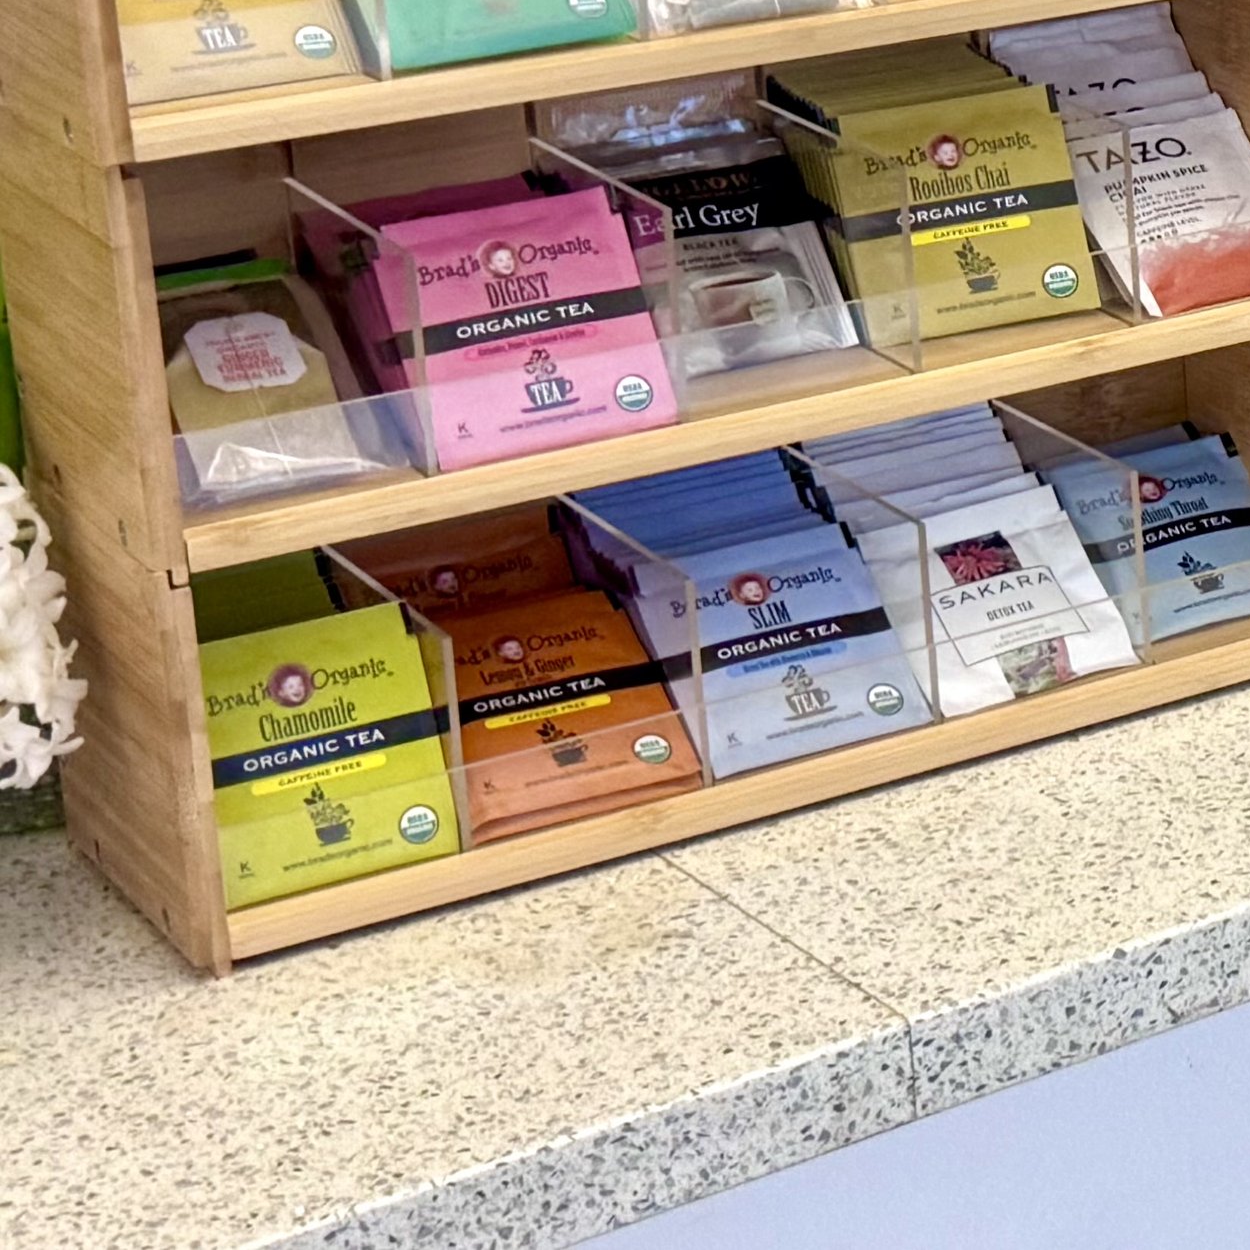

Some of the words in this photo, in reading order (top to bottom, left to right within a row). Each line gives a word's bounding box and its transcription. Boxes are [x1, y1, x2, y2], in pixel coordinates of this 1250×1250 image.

[201, 26, 237, 51] TEA
[864, 145, 927, 176] Brad's
[962, 130, 1031, 157] Organic
[1075, 137, 1187, 174] TAZO
[908, 169, 973, 201] Rooibos
[975, 162, 1011, 190] Chai
[1104, 169, 1171, 195] PUMPKIN
[1173, 163, 1209, 178] SPICE
[633, 206, 695, 237] Earl
[698, 202, 759, 227] Grey
[896, 201, 987, 226] ORGANIC
[992, 193, 1029, 208] TEA
[933, 225, 981, 240] CAFFEINE
[982, 219, 1009, 232] FREE
[418, 254, 481, 286] Brad's
[518, 236, 593, 264] Organic
[485, 271, 551, 309] DIGEST
[456, 309, 552, 339] ORGANIC
[555, 301, 595, 319] TEA
[530, 381, 563, 407] TEA
[1116, 521, 1197, 554] ORGANIC
[1199, 514, 1232, 529] TEA
[767, 567, 834, 593] Organic
[938, 571, 1054, 610] SAKARA
[748, 600, 792, 630] SLIM
[986, 604, 1016, 621] DETOX
[1016, 600, 1035, 612] TEA
[527, 626, 598, 651] Organic
[716, 631, 802, 660] ORGANIC
[806, 623, 843, 639] TEA
[535, 655, 576, 673] Ginger
[208, 680, 271, 718] Brad's
[310, 657, 387, 690] Organic
[473, 686, 563, 713] ORGANIC
[566, 676, 606, 693] TEA
[791, 692, 821, 715] TEA
[259, 697, 358, 743] Chamomile
[243, 739, 340, 773] ORGANIC
[345, 728, 386, 748] TEA
[278, 768, 331, 787] CAFFEINE
[334, 760, 363, 774] FREE
